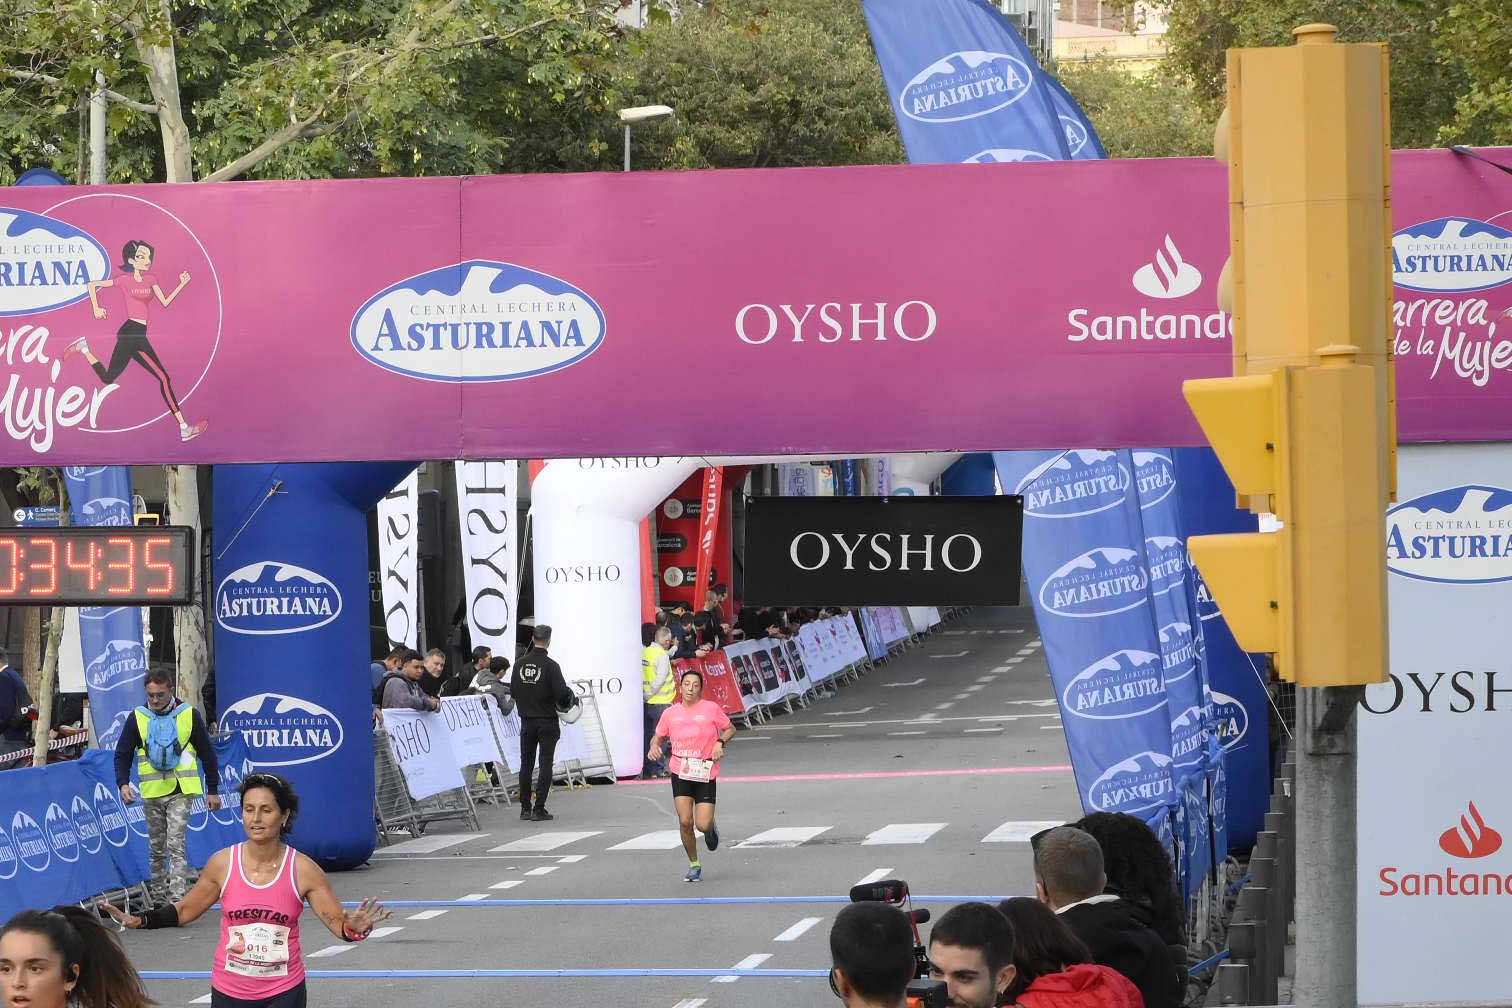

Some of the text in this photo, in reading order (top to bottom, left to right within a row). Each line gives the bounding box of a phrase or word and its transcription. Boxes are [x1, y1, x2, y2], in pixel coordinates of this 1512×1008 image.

[14, 243, 85, 257] LECHERA
[1407, 243, 1457, 252] CENTRAL
[409, 301, 578, 316] CENTRAL LECHERA
[734, 300, 937, 344] OYSHO
[1392, 298, 1488, 327] arrera
[370, 307, 586, 352] ASTURIANA
[1067, 309, 1232, 342] Santand
[1417, 329, 1435, 355] la
[1430, 326, 1512, 386] Muje
[1414, 520, 1480, 531] CENTRAL
[790, 531, 982, 574] OYSHO
[1386, 524, 1512, 560] ASTURIA
[545, 564, 621, 585] OYSHO
[232, 586, 328, 595] CENTRAL LECHERA
[219, 592, 333, 619] ASTURIANA
[577, 677, 623, 695] SHO
[1359, 670, 1512, 715] OYSH
[223, 721, 334, 748] TURIANA
[280, 717, 329, 725] LECHERA
[1378, 867, 1512, 896] Santan
[227, 908, 290, 924] FRESITAS
